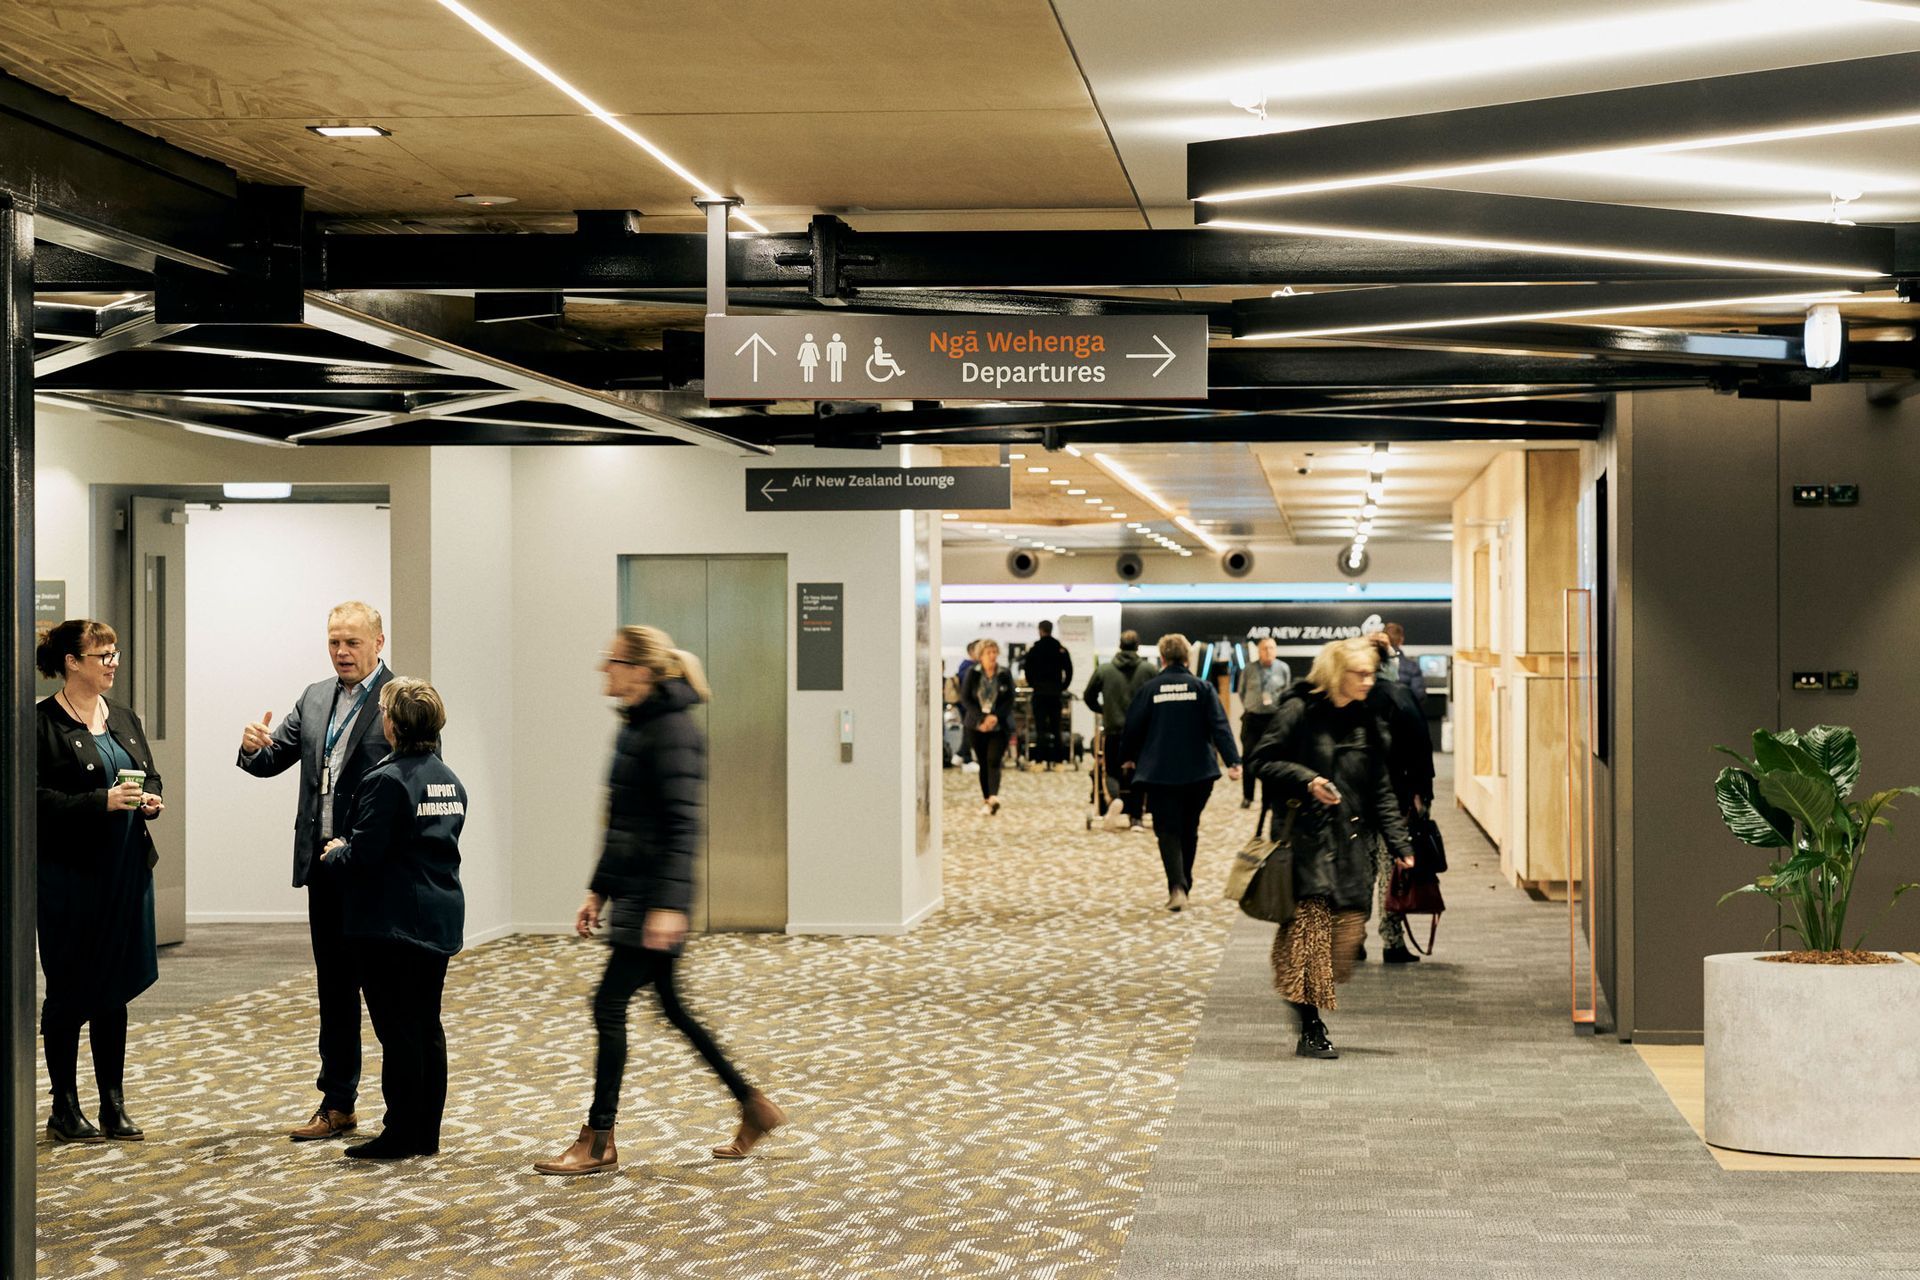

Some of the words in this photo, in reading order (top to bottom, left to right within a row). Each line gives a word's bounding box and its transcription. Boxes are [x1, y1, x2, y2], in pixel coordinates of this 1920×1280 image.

[930, 330, 980, 359] Ngā
[986, 329, 1106, 359] Wehenga
[962, 362, 1106, 389] Departures
[792, 475, 812, 487] Air
[815, 475, 846, 487] New
[849, 474, 902, 487] Zealand
[906, 474, 955, 489] Lounge
[1246, 626, 1271, 639] AIR
[1271, 626, 1302, 639] NEW
[1301, 626, 1361, 639] ZEALAND
[426, 783, 456, 798] AIRPORT
